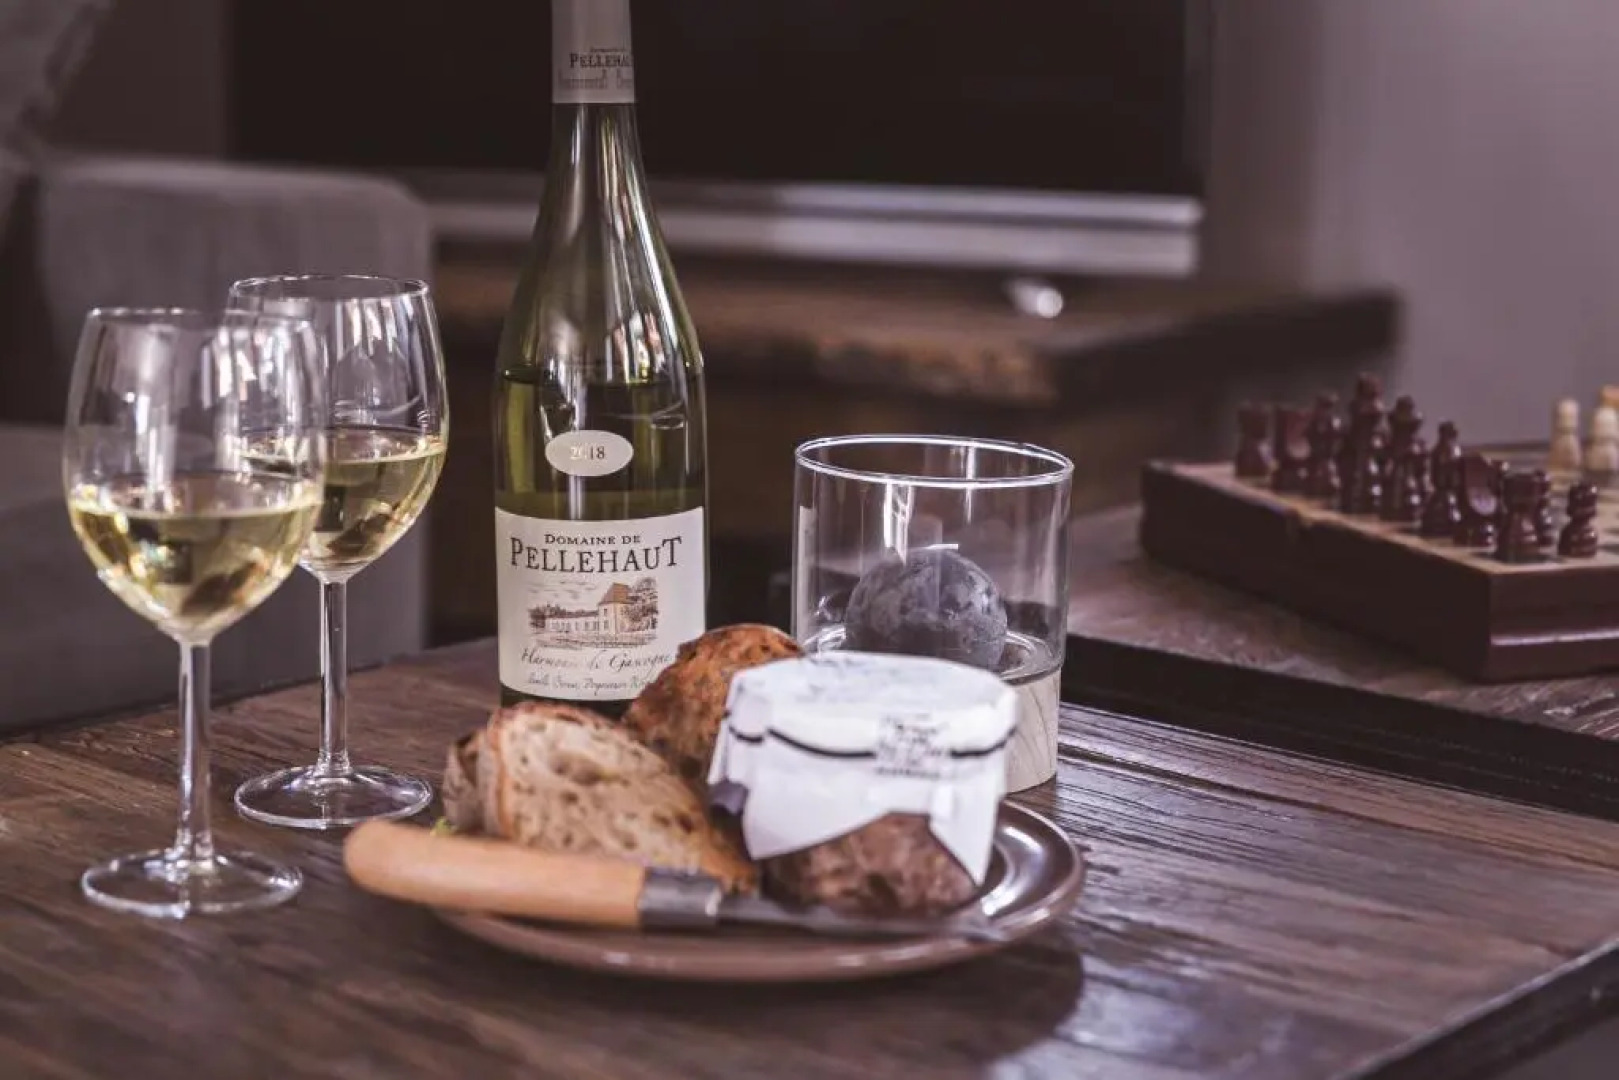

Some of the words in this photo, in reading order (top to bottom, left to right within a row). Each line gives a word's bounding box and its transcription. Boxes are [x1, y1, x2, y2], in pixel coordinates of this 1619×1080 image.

[544, 533, 616, 546] DOMAINE
[621, 534, 642, 545] DE
[510, 535, 683, 573] PELLEHAUT
